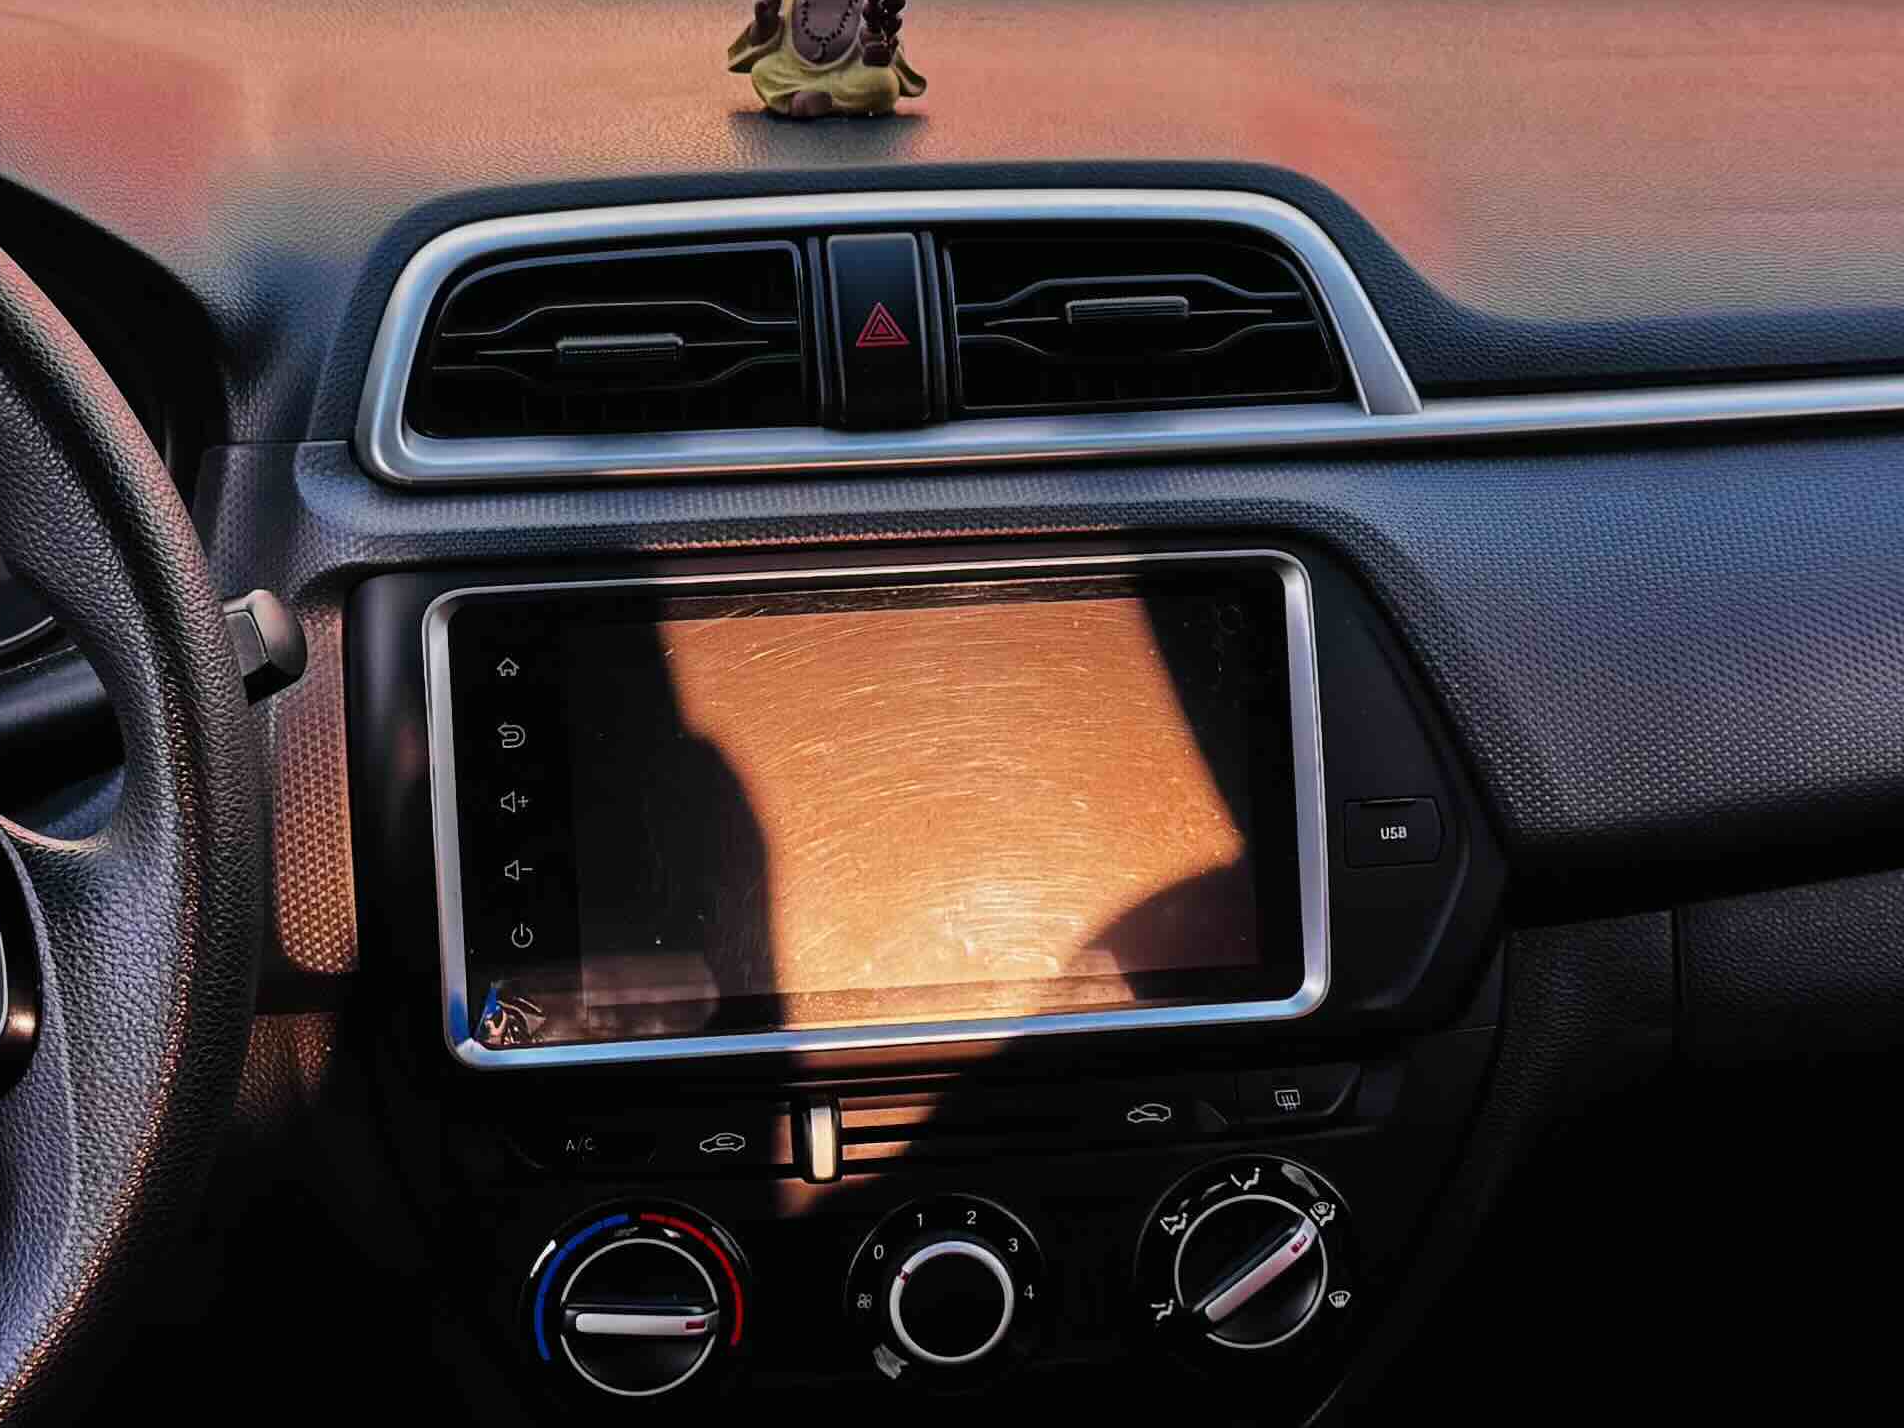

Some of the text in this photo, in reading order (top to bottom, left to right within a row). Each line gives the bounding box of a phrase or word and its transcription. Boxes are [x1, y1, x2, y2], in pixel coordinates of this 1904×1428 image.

[1380, 826, 1408, 840] USB
[565, 1137, 595, 1152] A/C
[916, 1213, 924, 1227] 1
[966, 1210, 977, 1225] 2
[873, 1244, 884, 1260] 0
[1008, 1237, 1019, 1253] 3
[1023, 1284, 1035, 1300] 4
